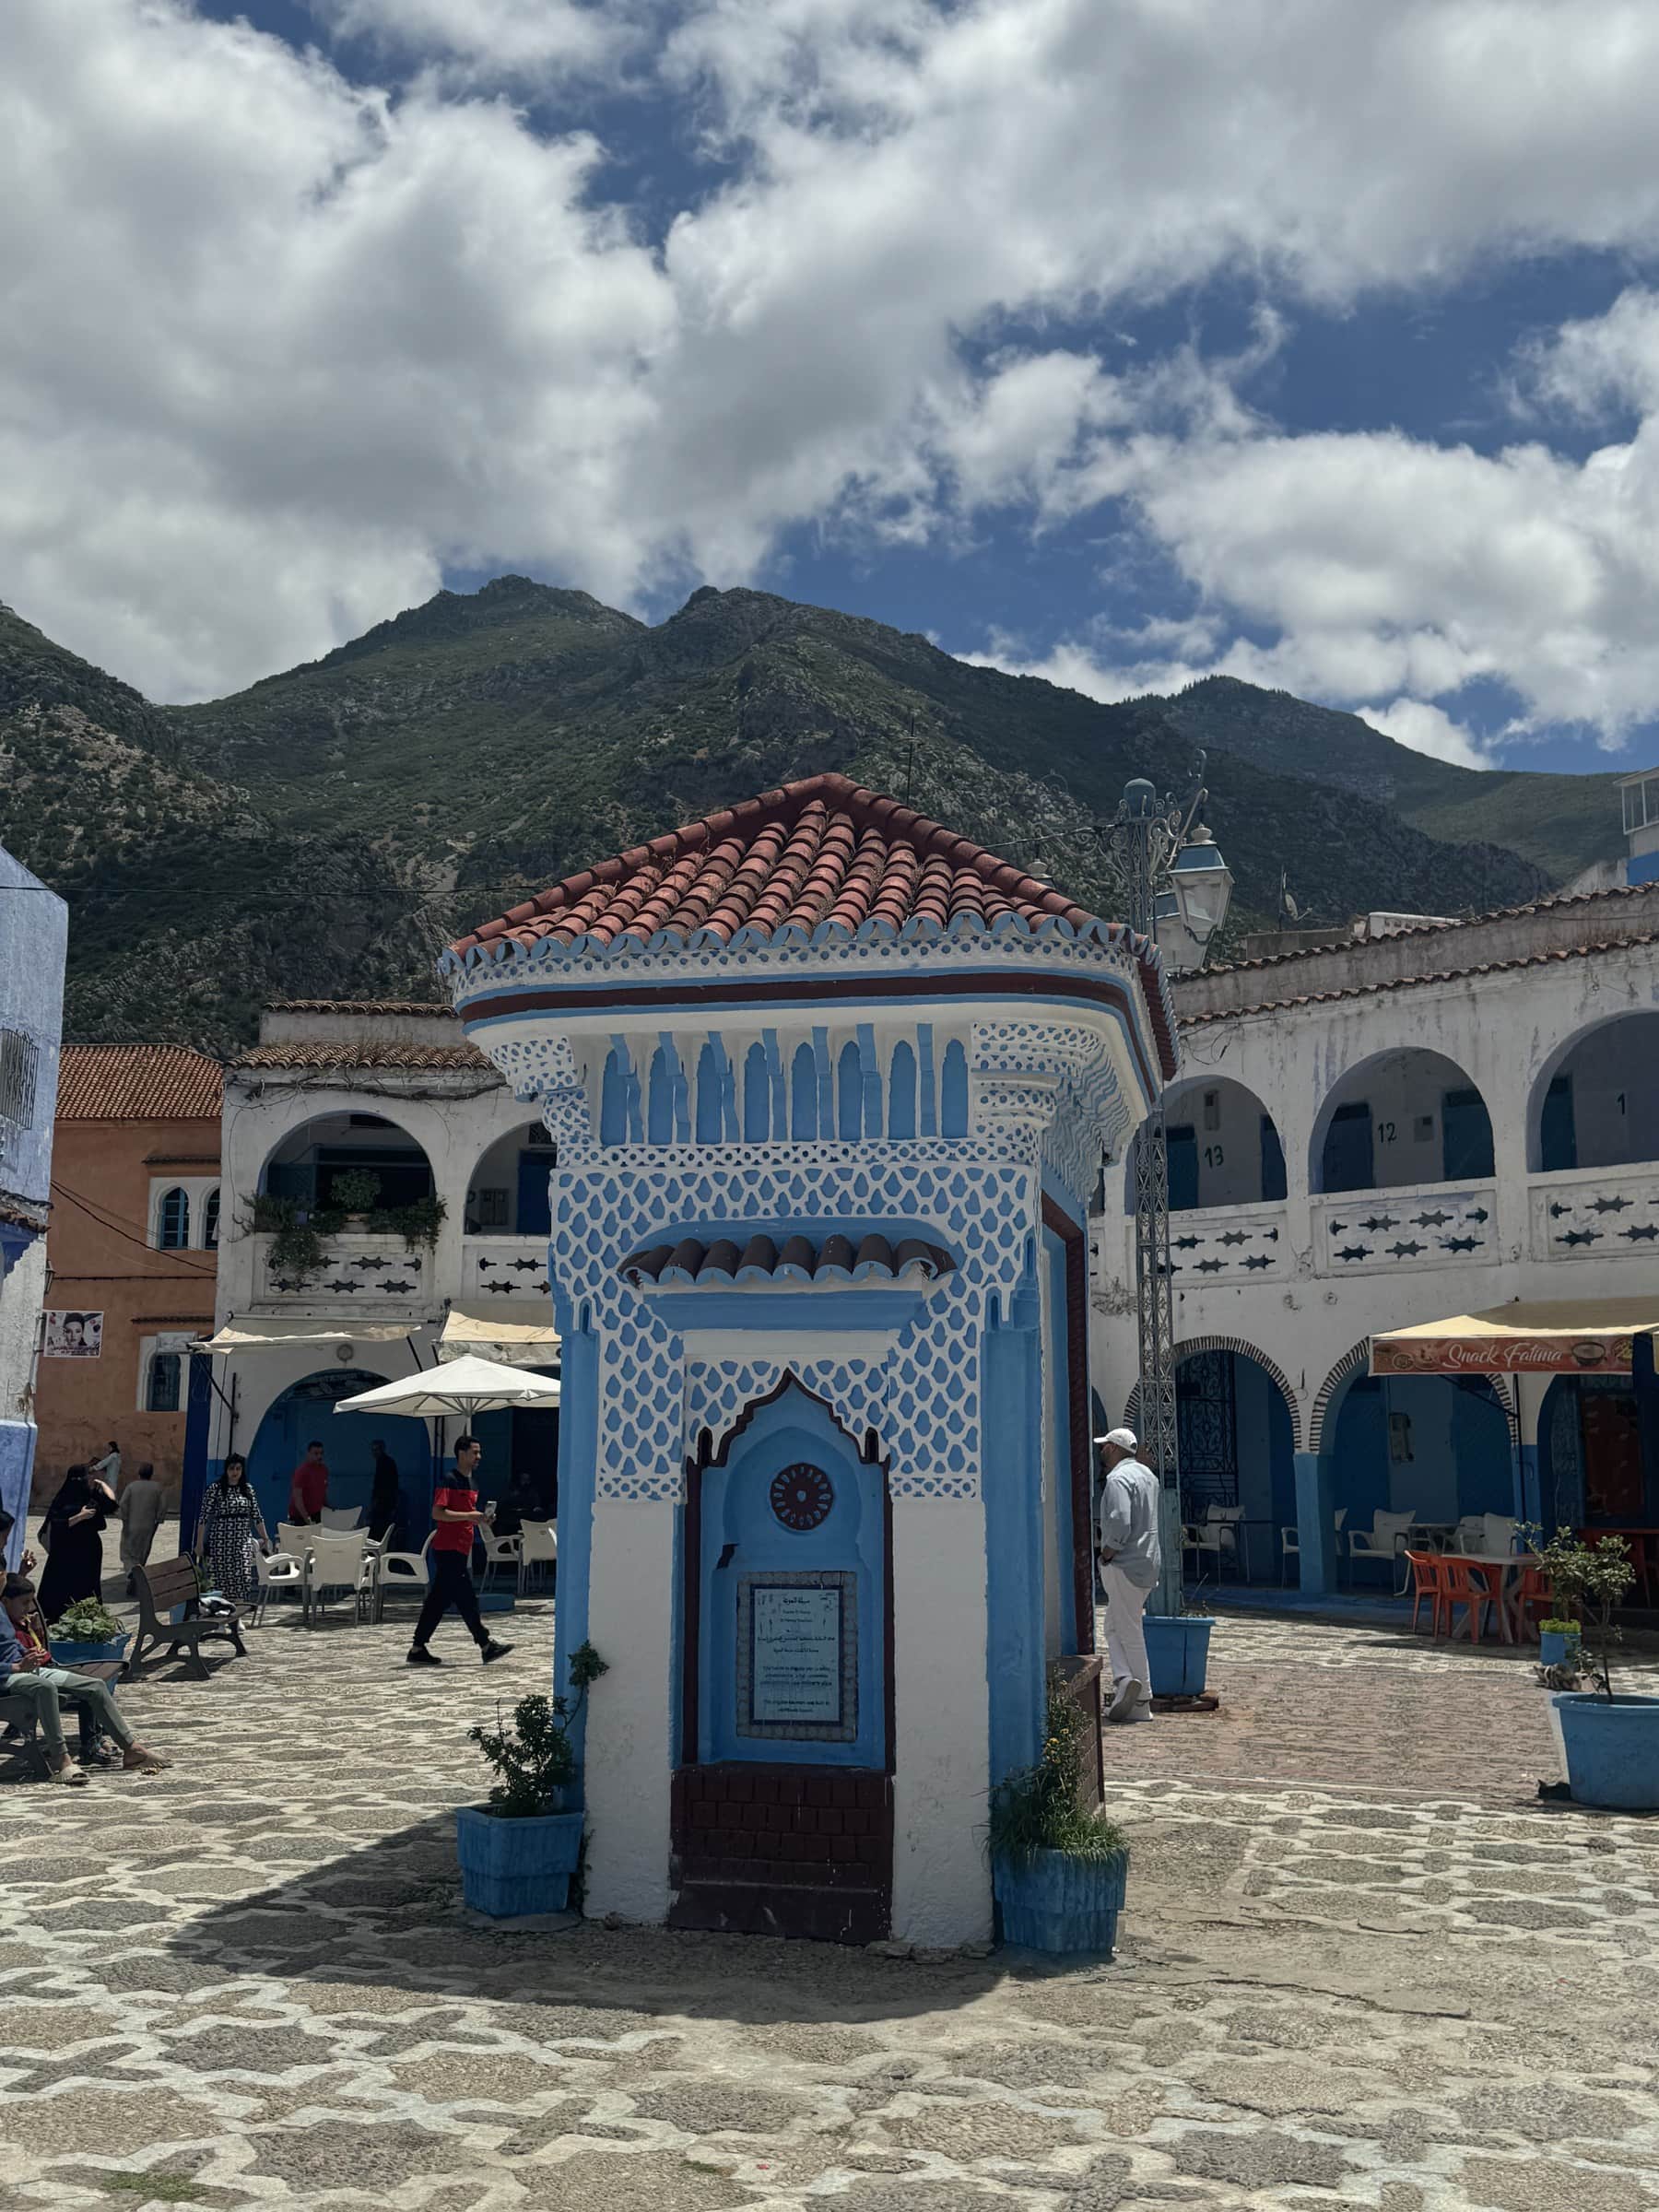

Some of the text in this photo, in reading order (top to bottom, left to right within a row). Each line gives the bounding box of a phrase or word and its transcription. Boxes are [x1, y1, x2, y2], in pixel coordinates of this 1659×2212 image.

[1378, 1122, 1397, 1144] 12
[1205, 1145, 1225, 1169] 13
[1441, 1342, 1563, 1370] Snack Fatima
